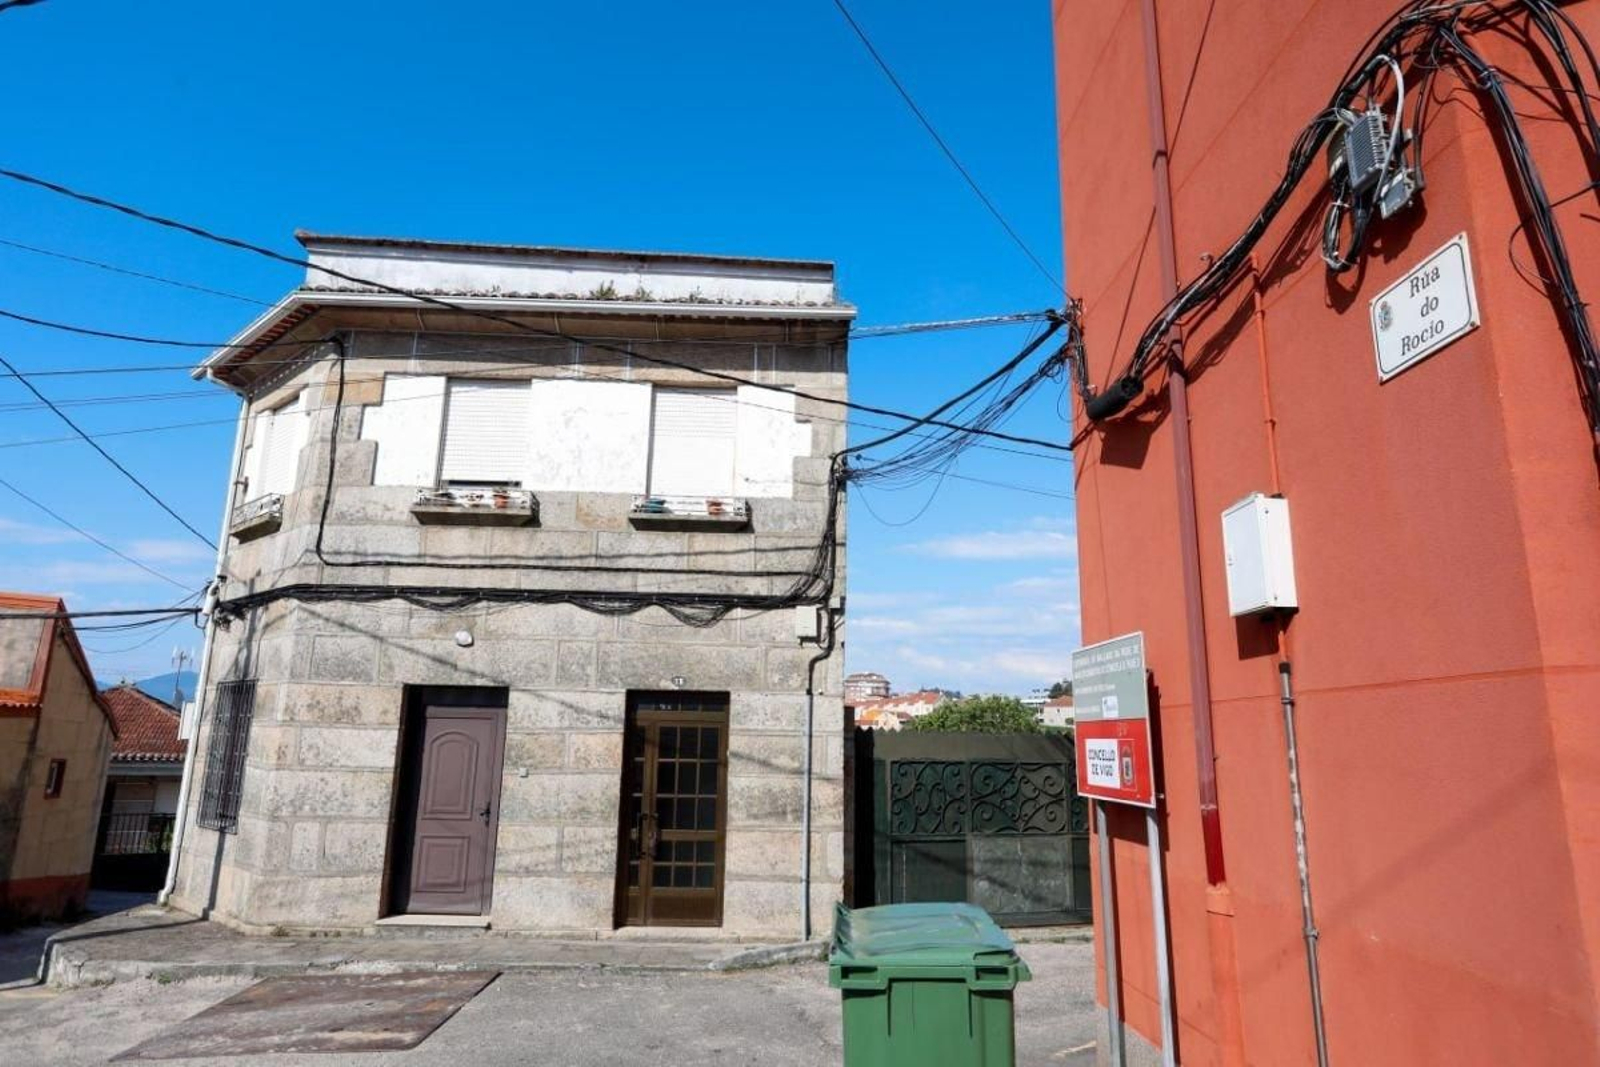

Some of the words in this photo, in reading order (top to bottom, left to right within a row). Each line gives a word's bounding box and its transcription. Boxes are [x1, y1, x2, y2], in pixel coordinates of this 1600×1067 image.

[1409, 266, 1441, 298] Rúa
[1420, 296, 1439, 317] do
[1088, 749, 1116, 762] CONCELLO
[1091, 763, 1099, 775] DE
[1100, 764, 1114, 777] VIGO
